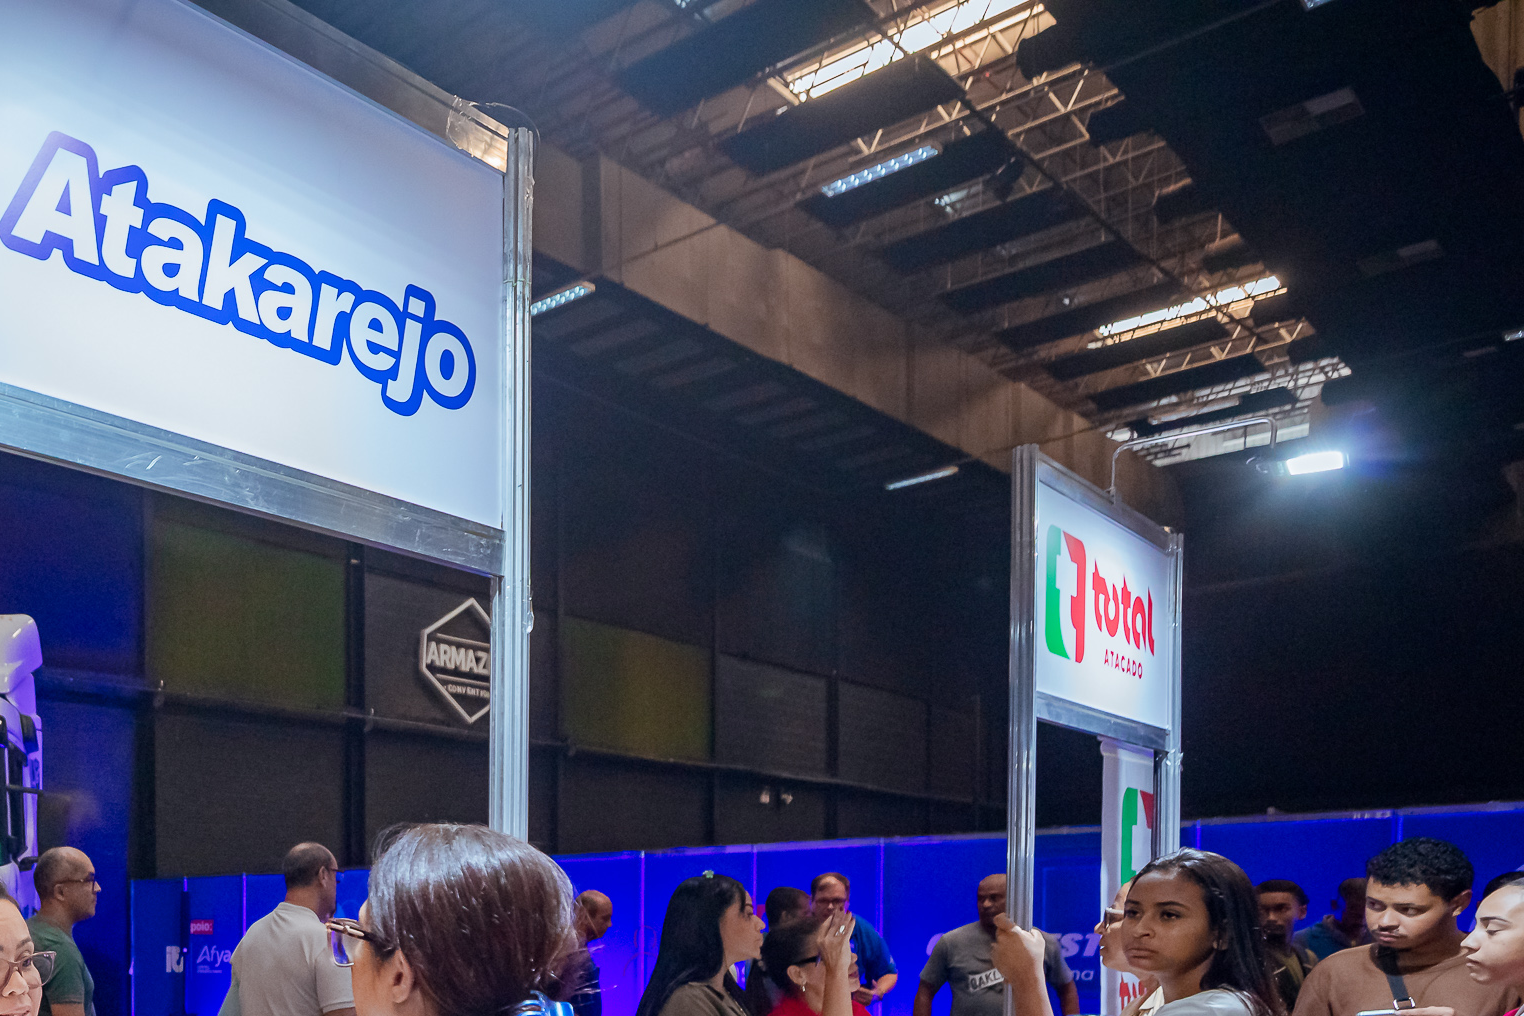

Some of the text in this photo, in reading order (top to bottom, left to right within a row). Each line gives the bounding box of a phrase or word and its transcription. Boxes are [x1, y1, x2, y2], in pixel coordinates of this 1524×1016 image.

[1092, 558, 1155, 656] total
[1104, 649, 1143, 679] ATACADO
[197, 945, 232, 968] Afya
